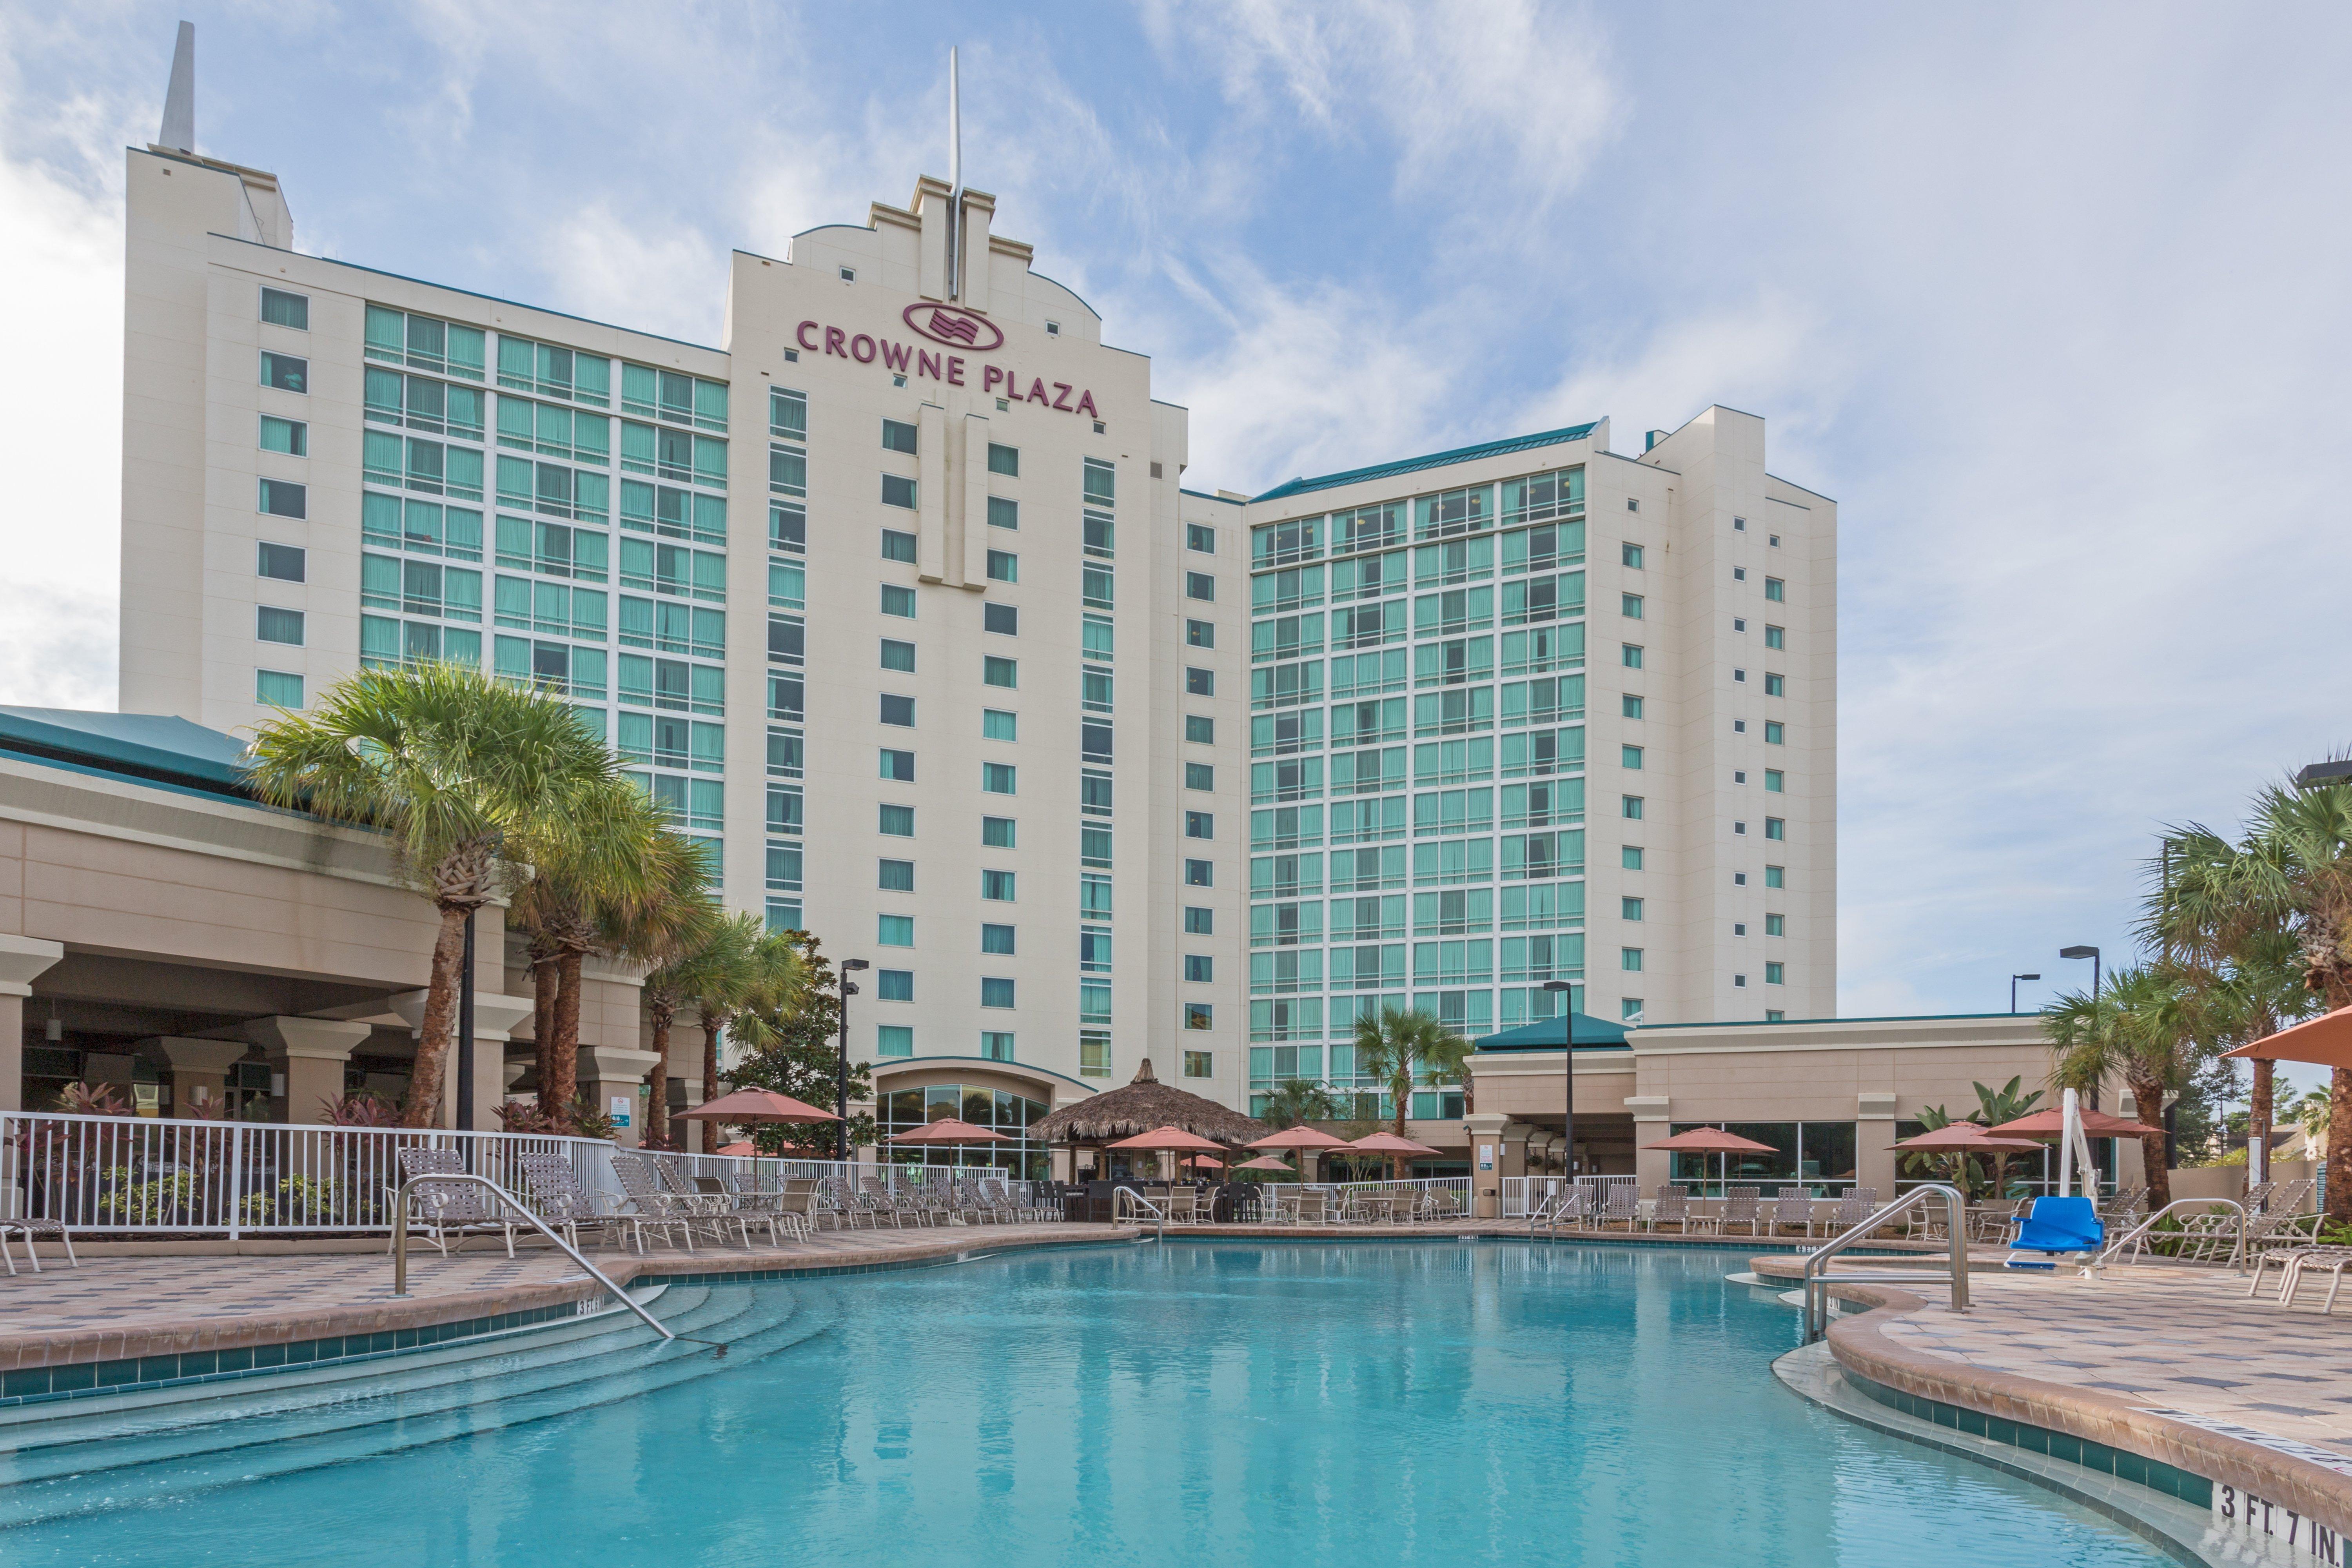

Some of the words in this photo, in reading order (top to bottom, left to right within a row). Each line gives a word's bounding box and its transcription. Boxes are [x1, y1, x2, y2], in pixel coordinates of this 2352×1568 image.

[797, 320, 965, 386] CROWNE
[984, 364, 1098, 418] PLAZA
[580, 1300, 584, 1314] 3
[1830, 1296, 1833, 1308] 3
[2221, 1485, 2235, 1518] 3
[2246, 1493, 2274, 1535] FT.
[2287, 1509, 2299, 1545] 7
[2311, 1520, 2340, 1568] IN.
